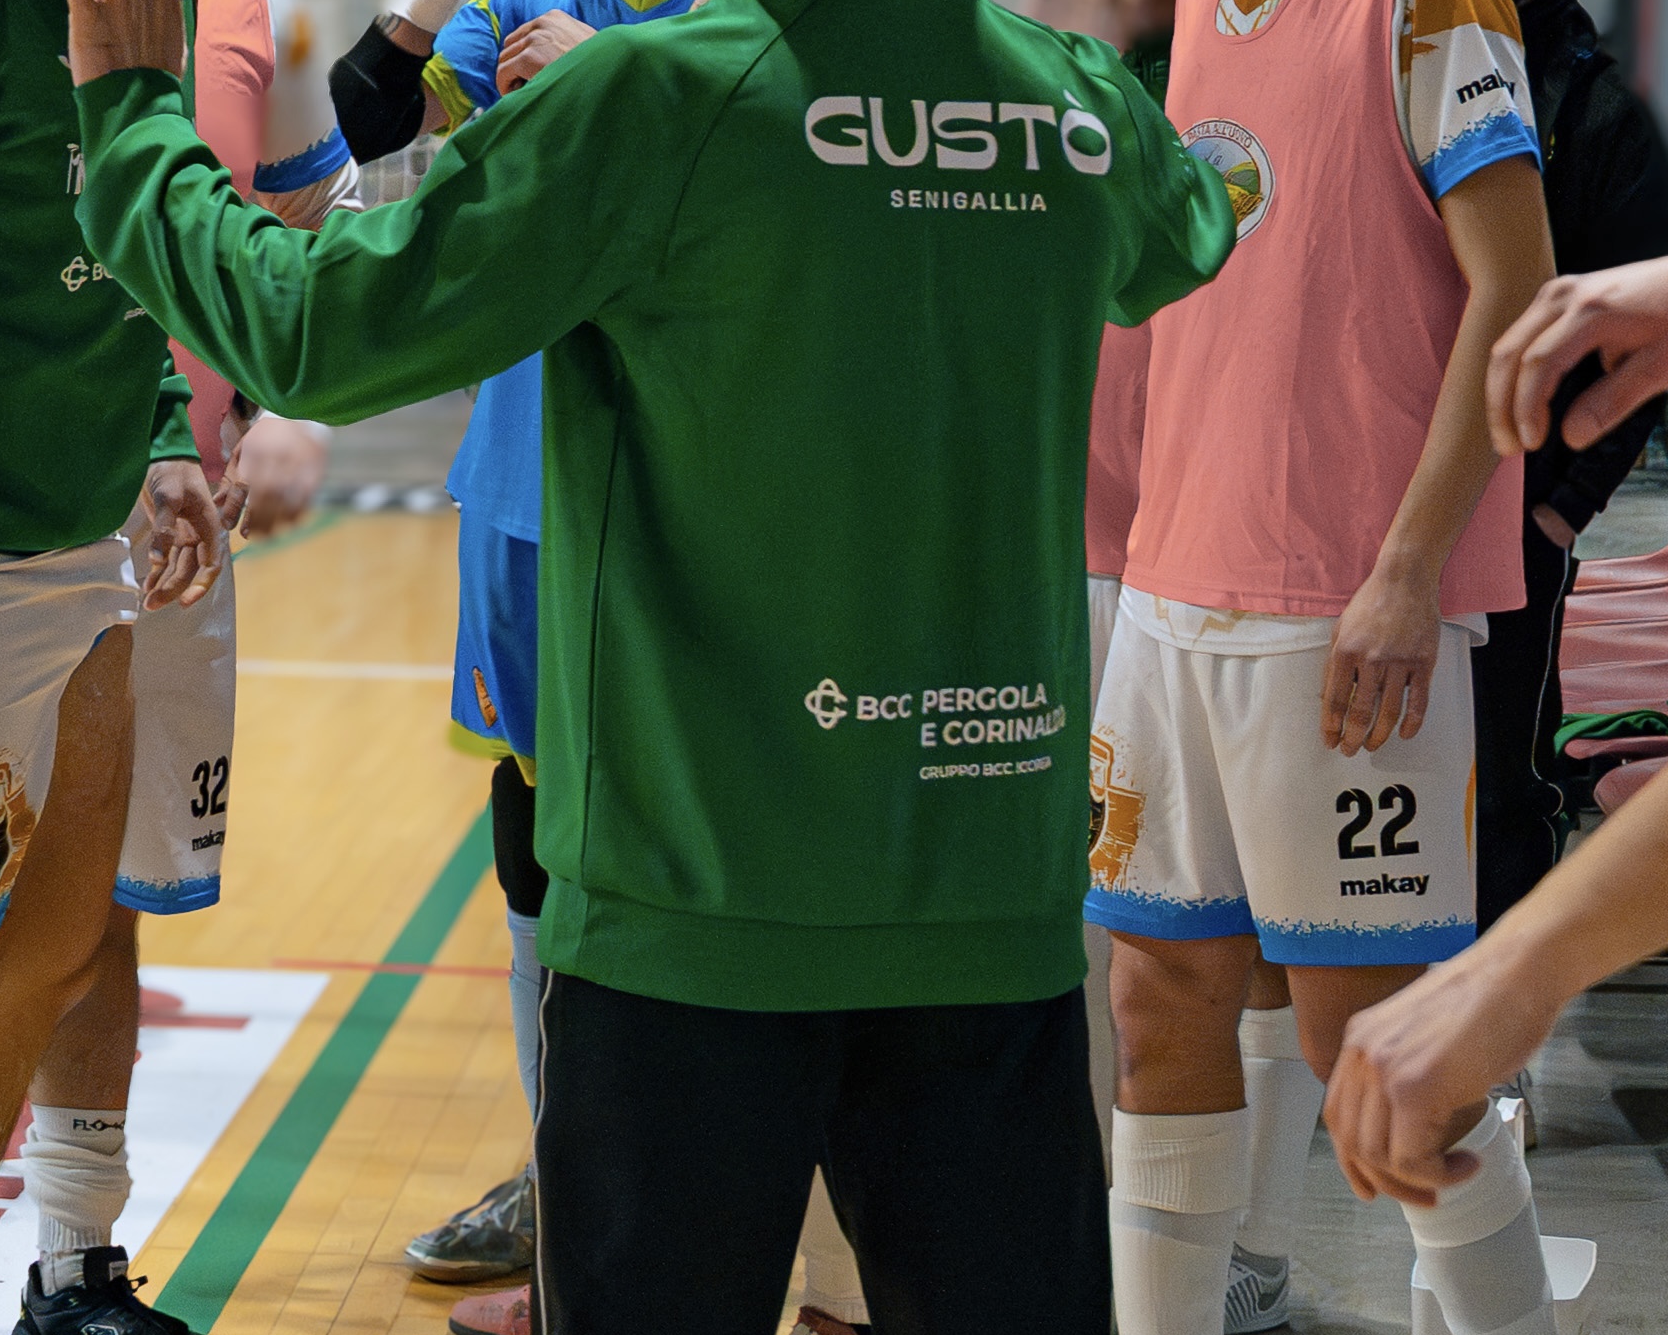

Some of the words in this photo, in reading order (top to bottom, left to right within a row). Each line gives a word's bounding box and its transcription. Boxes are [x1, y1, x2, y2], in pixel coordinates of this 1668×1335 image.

[804, 89, 1112, 175] GUSTÒ
[890, 189, 1047, 212] SENIGALLIA
[856, 694, 912, 720] BCC
[921, 683, 1047, 715] PERGOLA
[920, 722, 937, 748] E
[919, 763, 980, 780] GRUPPO
[982, 762, 1013, 777] BCC
[191, 755, 229, 819] 32
[1336, 784, 1420, 860] 22
[1340, 873, 1430, 897] makay
